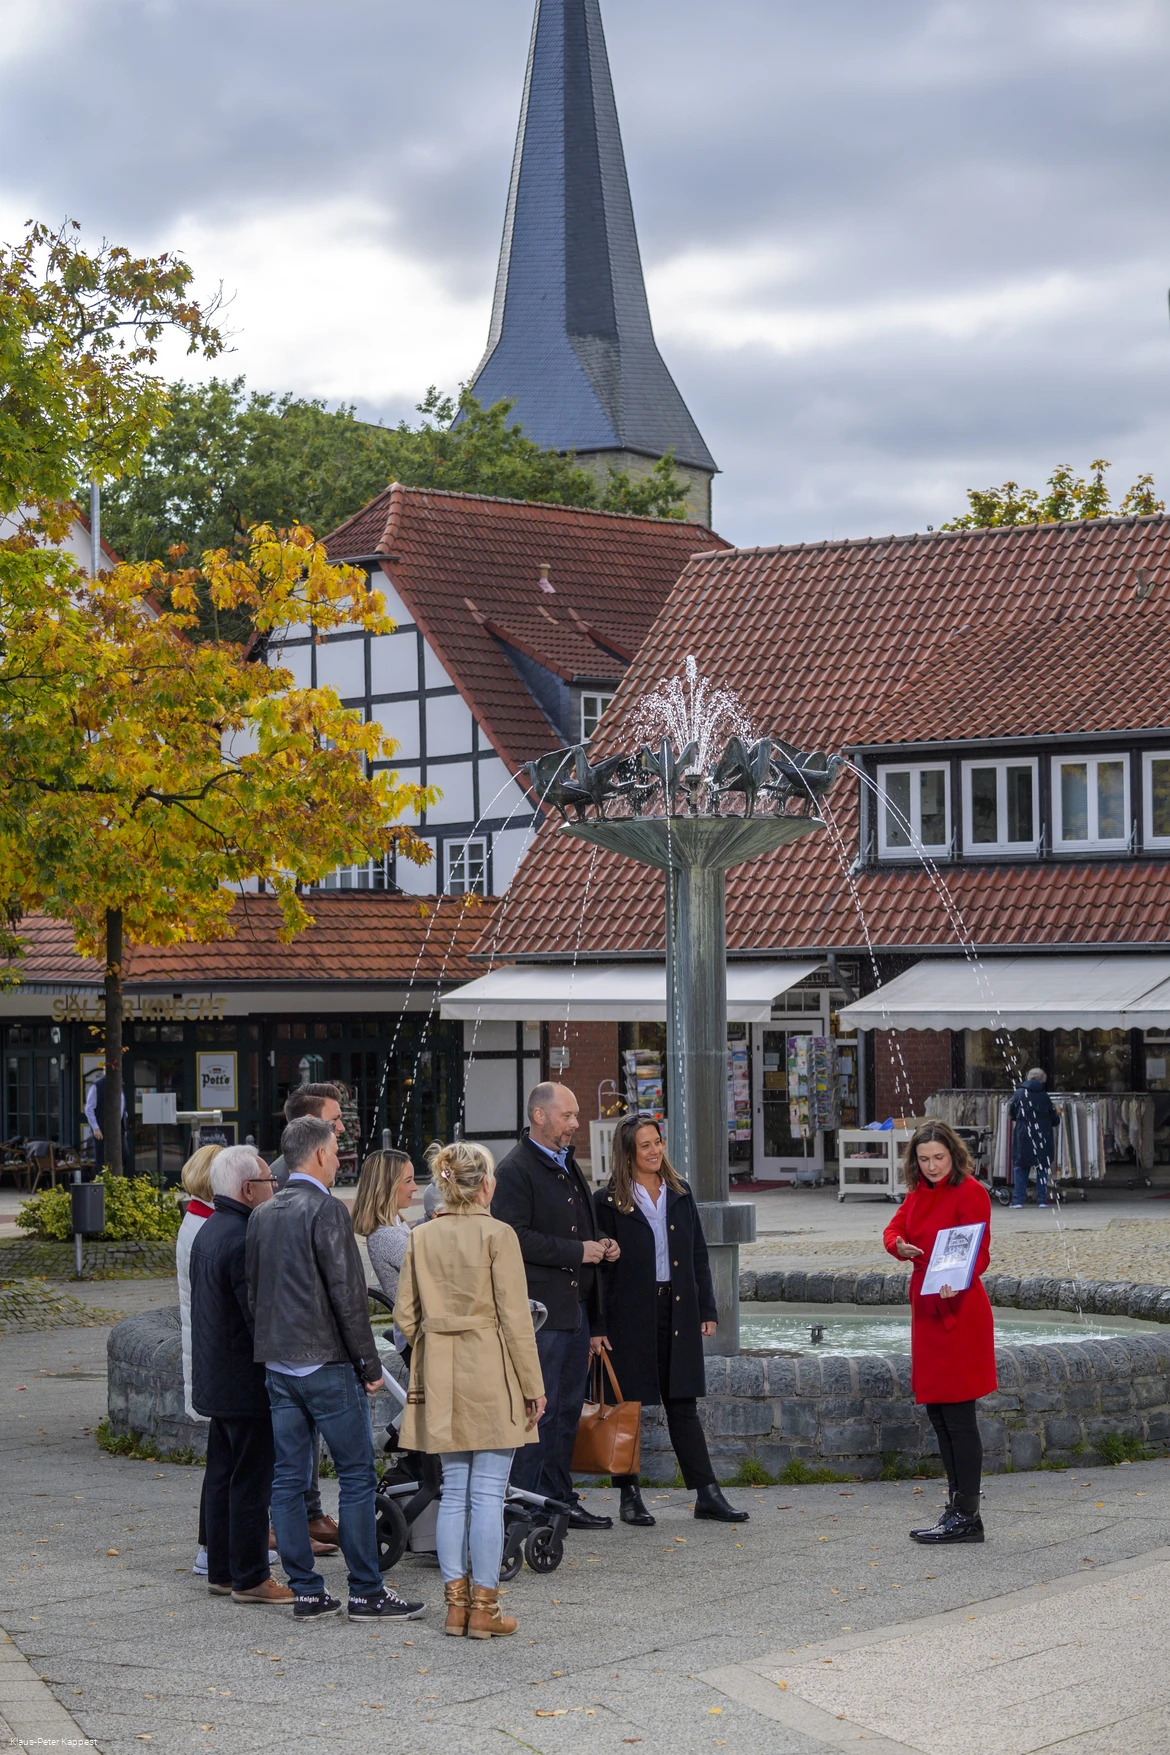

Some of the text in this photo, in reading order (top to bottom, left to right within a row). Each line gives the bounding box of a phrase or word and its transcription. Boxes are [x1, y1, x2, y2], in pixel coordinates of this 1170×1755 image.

[51, 995, 230, 1022] SÄLZR KNECHT
[299, 1595, 320, 1604] Knights
